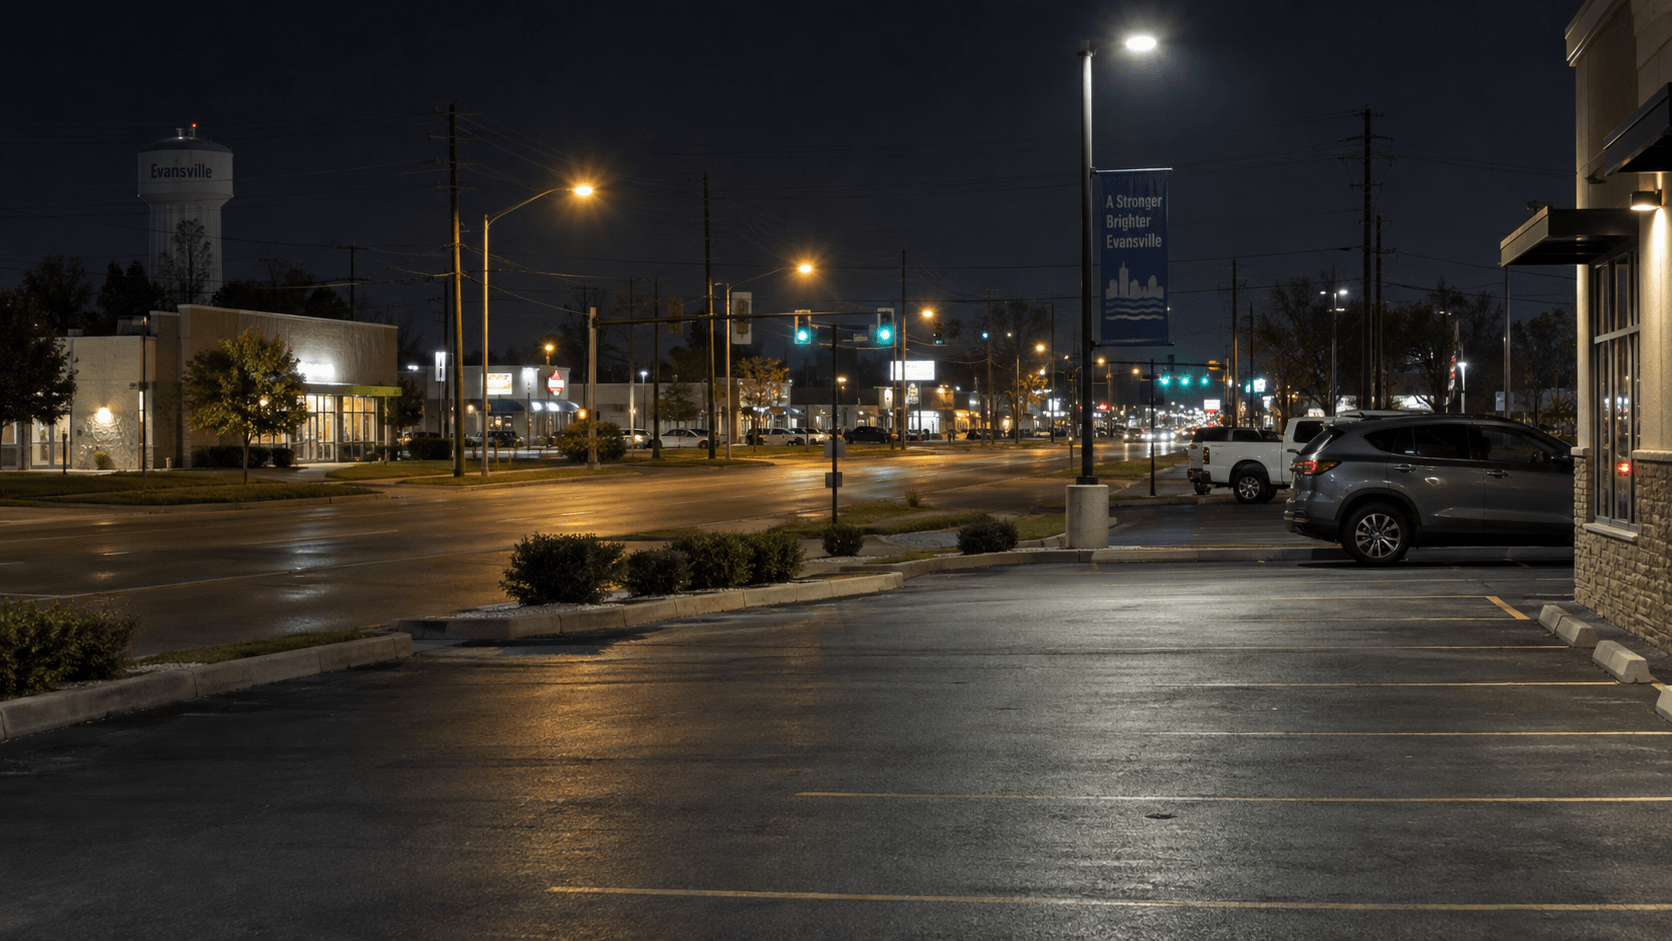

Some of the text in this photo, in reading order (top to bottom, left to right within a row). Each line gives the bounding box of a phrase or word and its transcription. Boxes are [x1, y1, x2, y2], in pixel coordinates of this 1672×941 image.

[151, 163, 212, 179] Evansville
[1105, 194, 1163, 211] A Stronger
[1106, 213, 1152, 232] Brighter
[1106, 232, 1162, 249] Evansville
